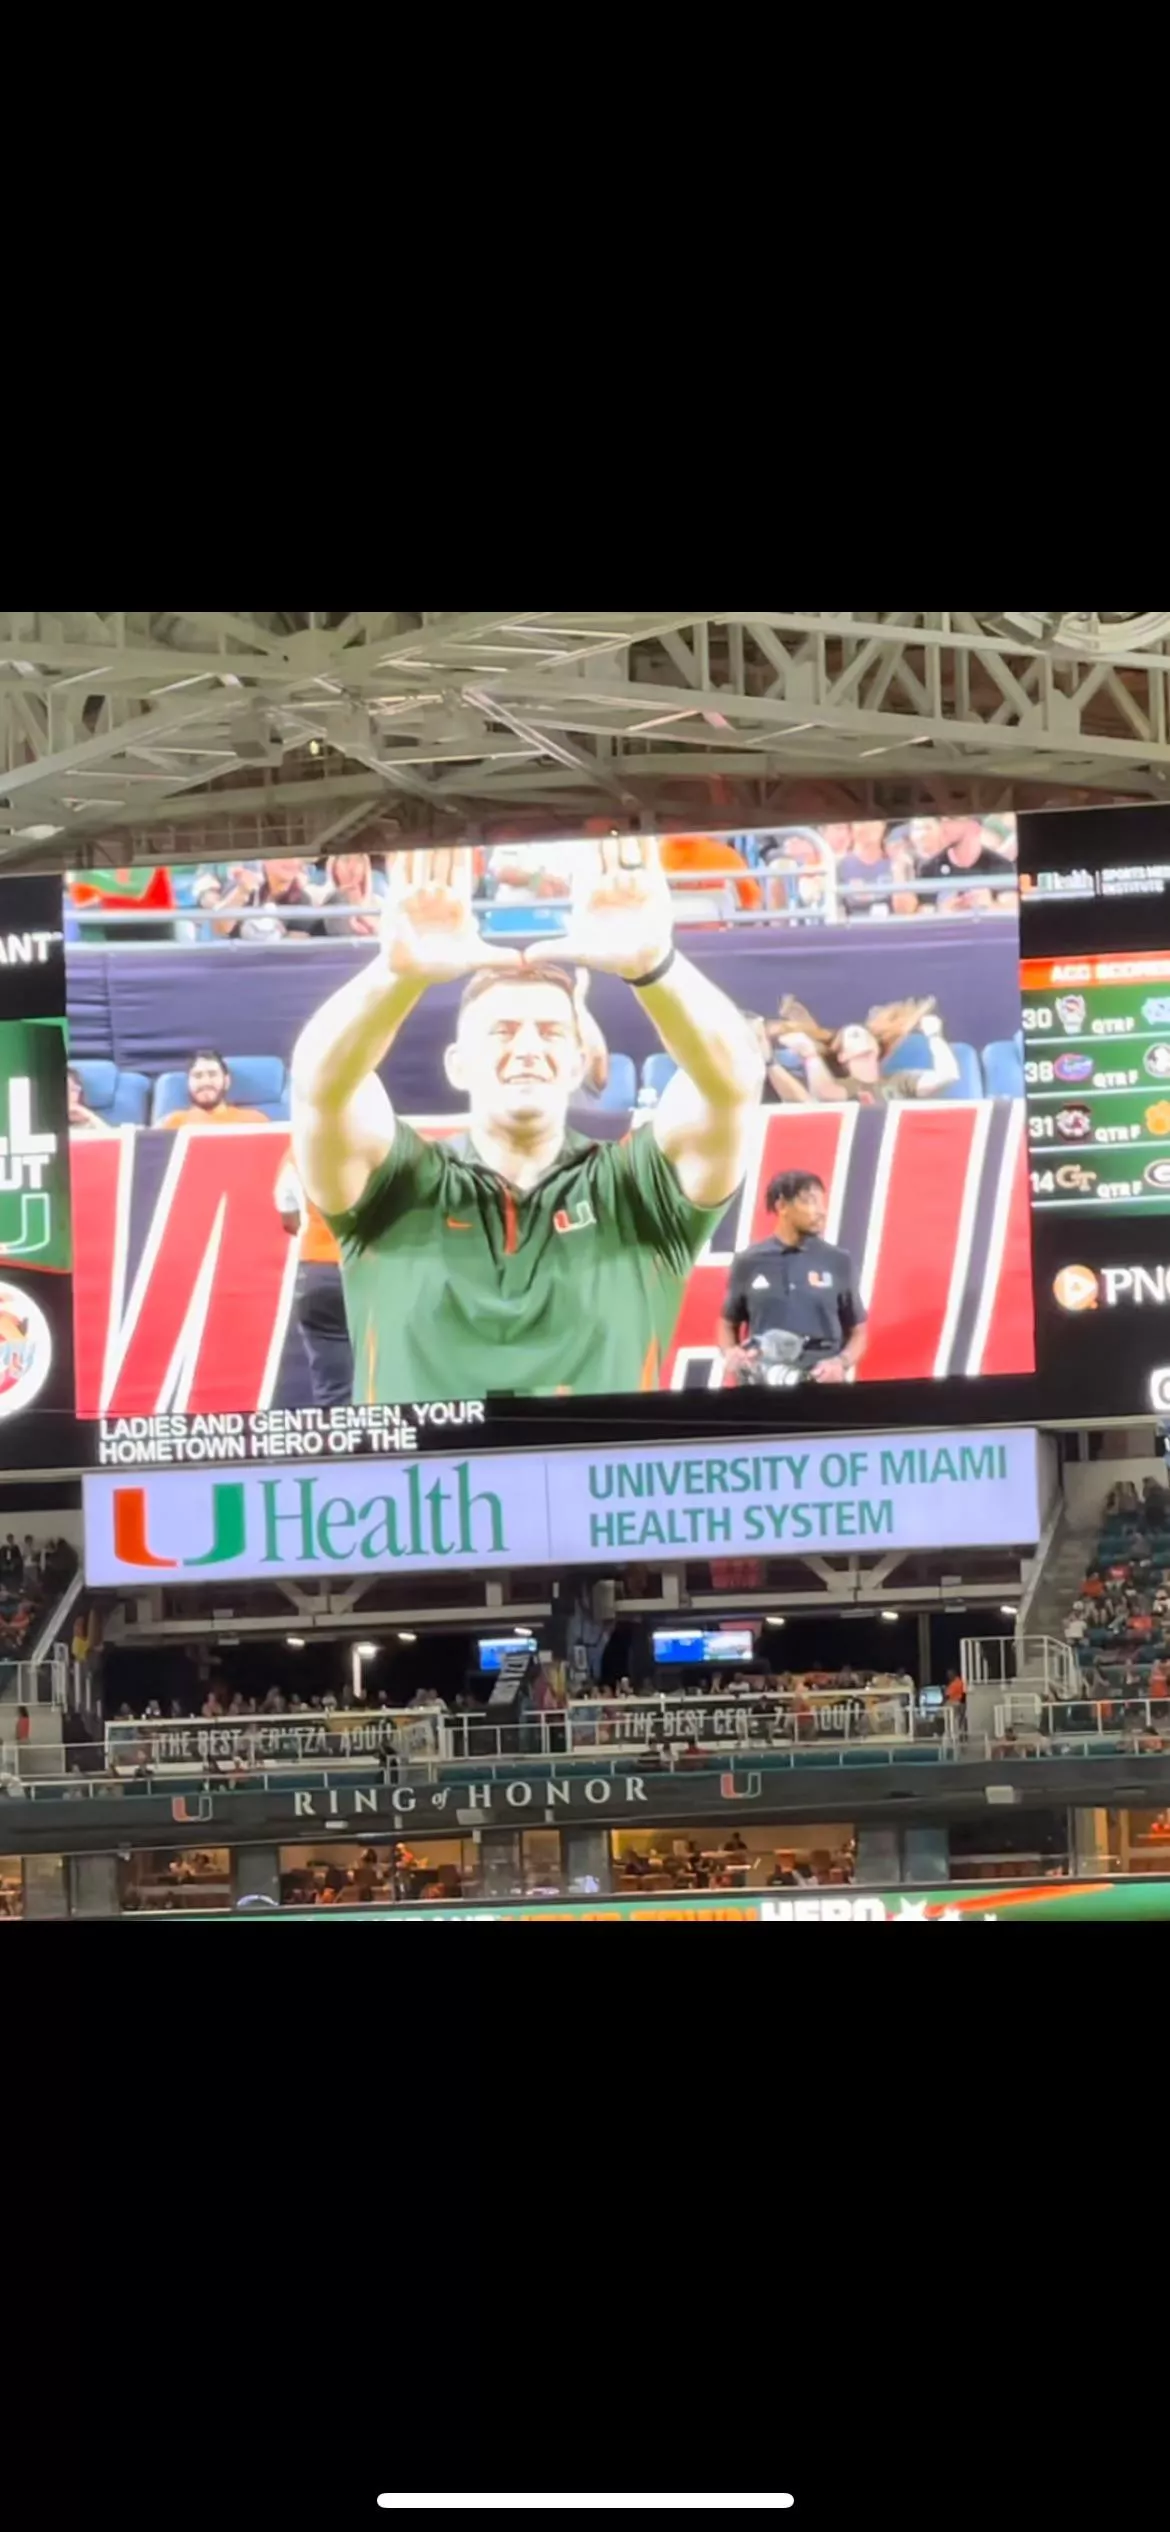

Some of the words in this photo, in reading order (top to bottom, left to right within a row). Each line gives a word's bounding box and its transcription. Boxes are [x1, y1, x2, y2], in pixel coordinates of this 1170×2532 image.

[1022, 1007, 1053, 1030] 30
[1091, 1017, 1124, 1034] QTR
[1024, 1060, 1054, 1083] 38
[1092, 1071, 1127, 1088] QTR
[1029, 1115, 1054, 1138] 31
[1094, 1126, 1129, 1142] QTR
[1031, 1169, 1055, 1193] 14
[1096, 1181, 1131, 1198] QTR
[1101, 1264, 1170, 1306] PN
[100, 1414, 188, 1441] LADIES
[192, 1413, 244, 1436] AND
[249, 1405, 408, 1434] GENTLEMEN,
[412, 1400, 486, 1426] YOUR
[100, 1435, 246, 1465] HOMETOWN
[251, 1431, 323, 1457] HERO
[328, 1429, 362, 1453] OF
[366, 1427, 418, 1451] THE
[588, 1454, 810, 1500] UNIVERSITY
[820, 1452, 868, 1488] OF
[880, 1445, 1007, 1486] MIAMI
[589, 1507, 732, 1548] HEALTH
[743, 1499, 894, 1541] SYSTEM
[662, 1708, 707, 1737] BEST
[198, 1727, 242, 1757] BEST
[294, 1786, 417, 1817] RING
[431, 1786, 449, 1811] of
[468, 1776, 649, 1809] HONOR
